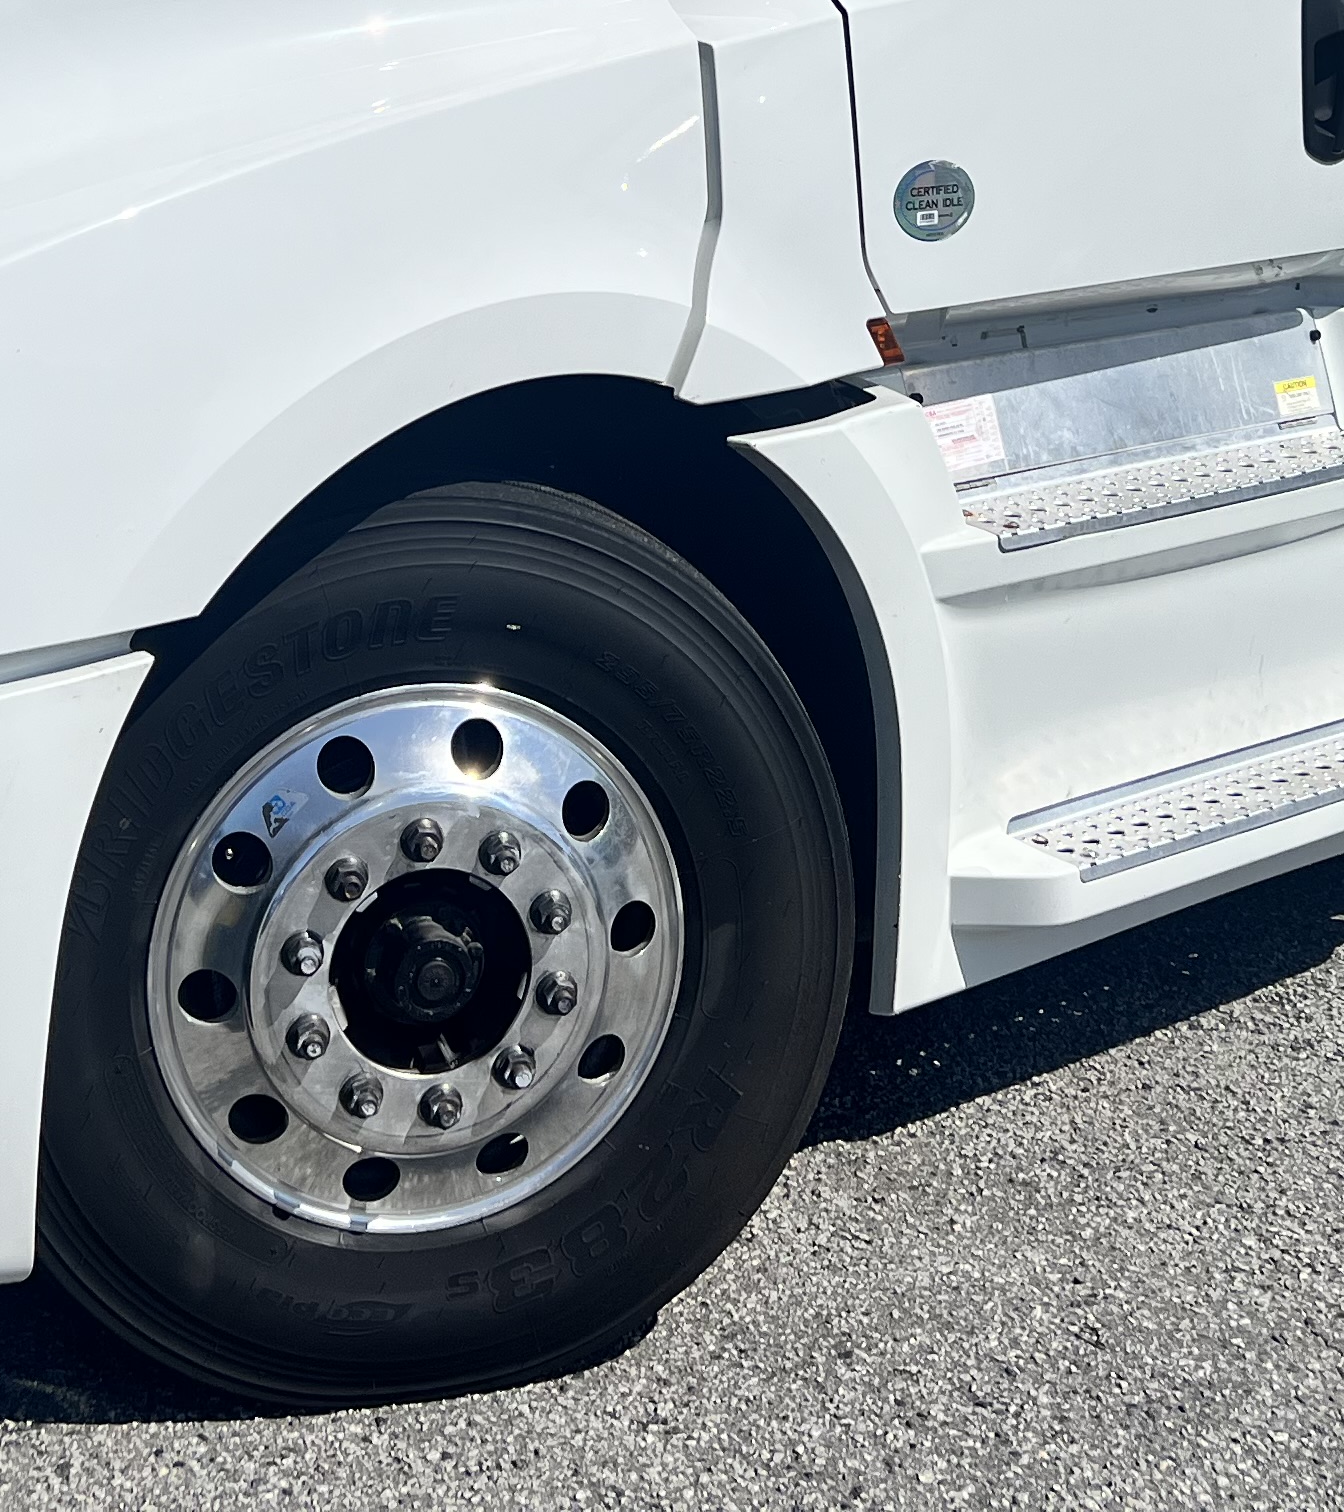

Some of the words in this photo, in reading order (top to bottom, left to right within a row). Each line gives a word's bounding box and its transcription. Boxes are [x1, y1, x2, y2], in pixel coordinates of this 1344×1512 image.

[910, 184, 959, 197] CERTIFIED
[905, 199, 938, 211] CLEAN
[942, 196, 963, 208] IDLE
[1283, 380, 1307, 390] CAUTION
[68, 594, 460, 942] BRIDGESTONE
